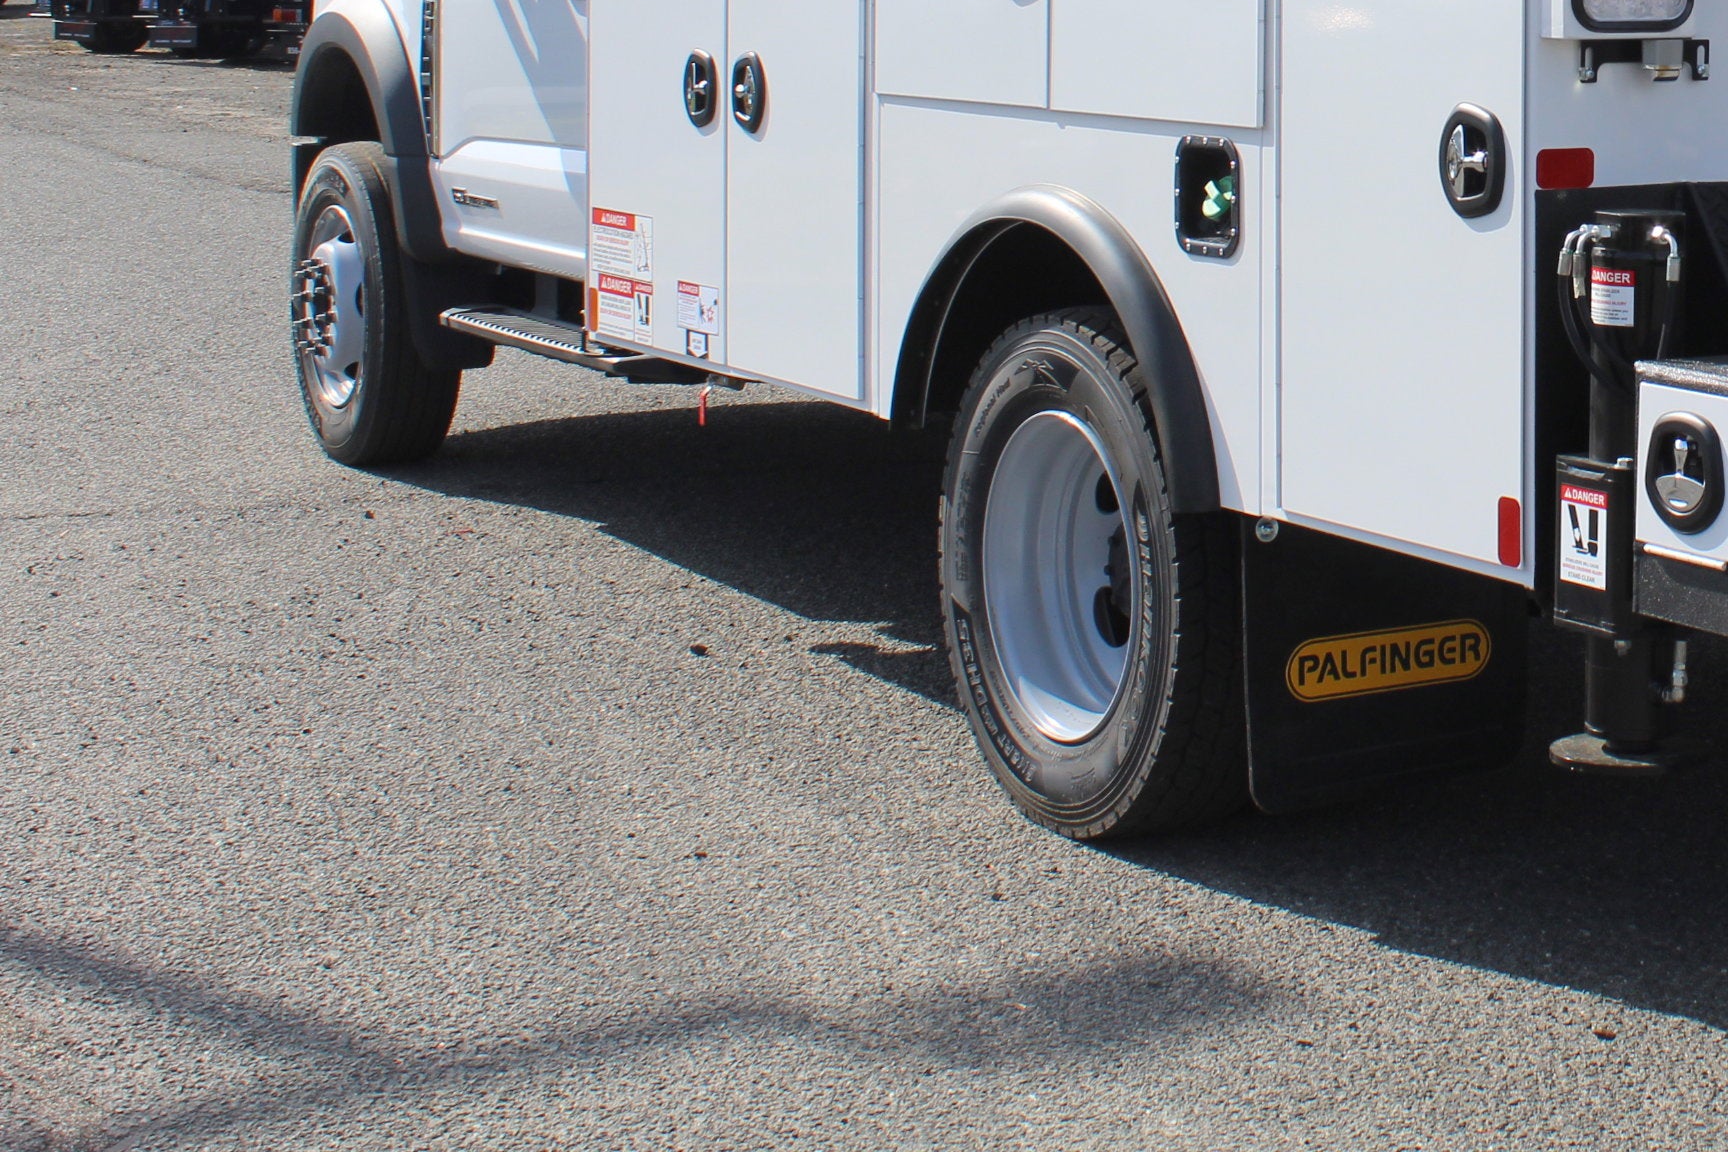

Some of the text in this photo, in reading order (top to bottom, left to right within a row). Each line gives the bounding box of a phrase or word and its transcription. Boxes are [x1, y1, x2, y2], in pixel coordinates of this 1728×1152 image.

[605, 213, 628, 227] DANGER
[1592, 269, 1631, 284] DANGER
[608, 278, 632, 294] DANGER
[1572, 488, 1605, 506] DANGER
[1298, 632, 1482, 687] PALFINGER
